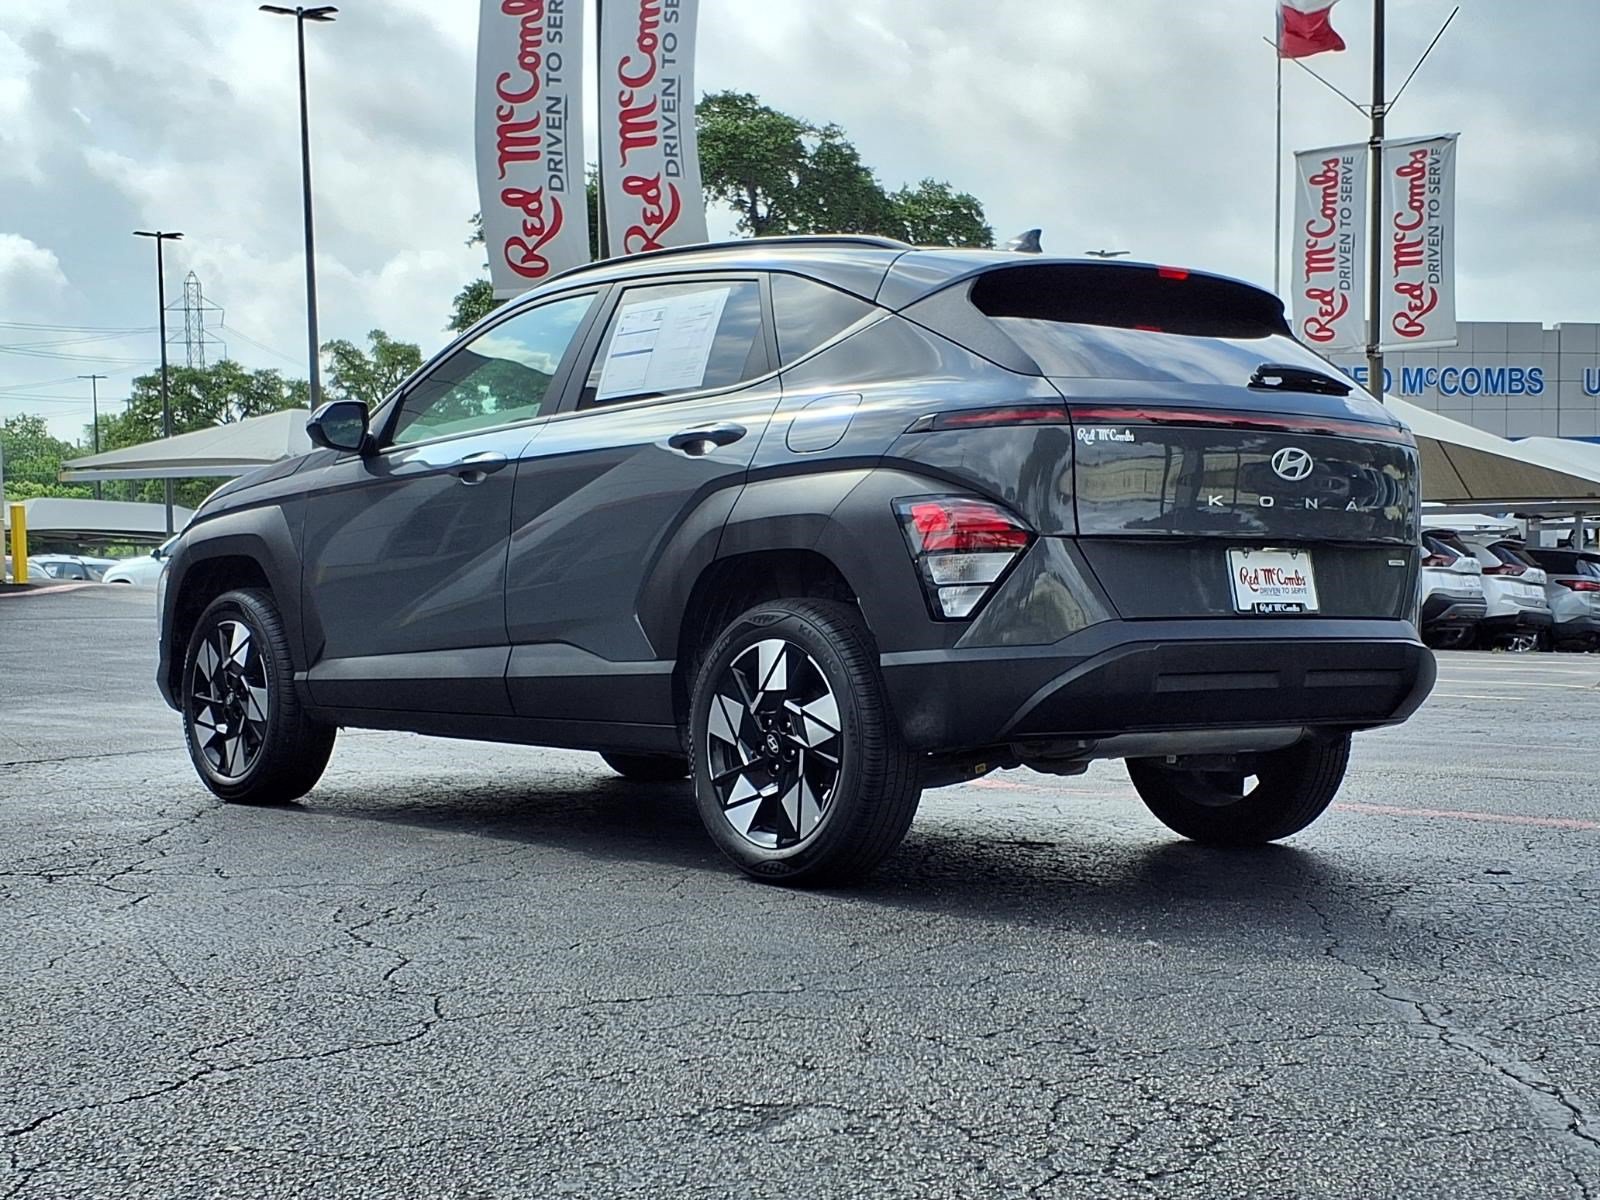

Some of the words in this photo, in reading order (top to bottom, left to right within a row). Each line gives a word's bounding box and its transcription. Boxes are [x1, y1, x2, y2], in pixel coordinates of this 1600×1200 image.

[546, 52, 563, 87] TO
[662, 32, 678, 69] TO
[495, 0, 544, 180] McComb
[546, 96, 565, 192] DRIVEN
[661, 78, 681, 177] DRIVEN
[1340, 156, 1354, 203] SERVE
[1428, 148, 1441, 195] SERVE
[501, 185, 563, 279] Red
[1305, 158, 1340, 283] McCombs
[1340, 208, 1352, 229] TO
[1394, 149, 1428, 278] McCombs
[1428, 199, 1440, 222] TO
[1339, 234, 1352, 291] DRIVEN
[1427, 226, 1440, 284] DRIVEN
[1304, 287, 1348, 342] Red
[1393, 281, 1438, 337] Red
[1208, 494, 1359, 512] KONA
[1240, 566, 1260, 592] Red
[1260, 567, 1307, 587] McCombs
[1260, 587, 1281, 595] DRIVEN
[1282, 587, 1290, 595] TO
